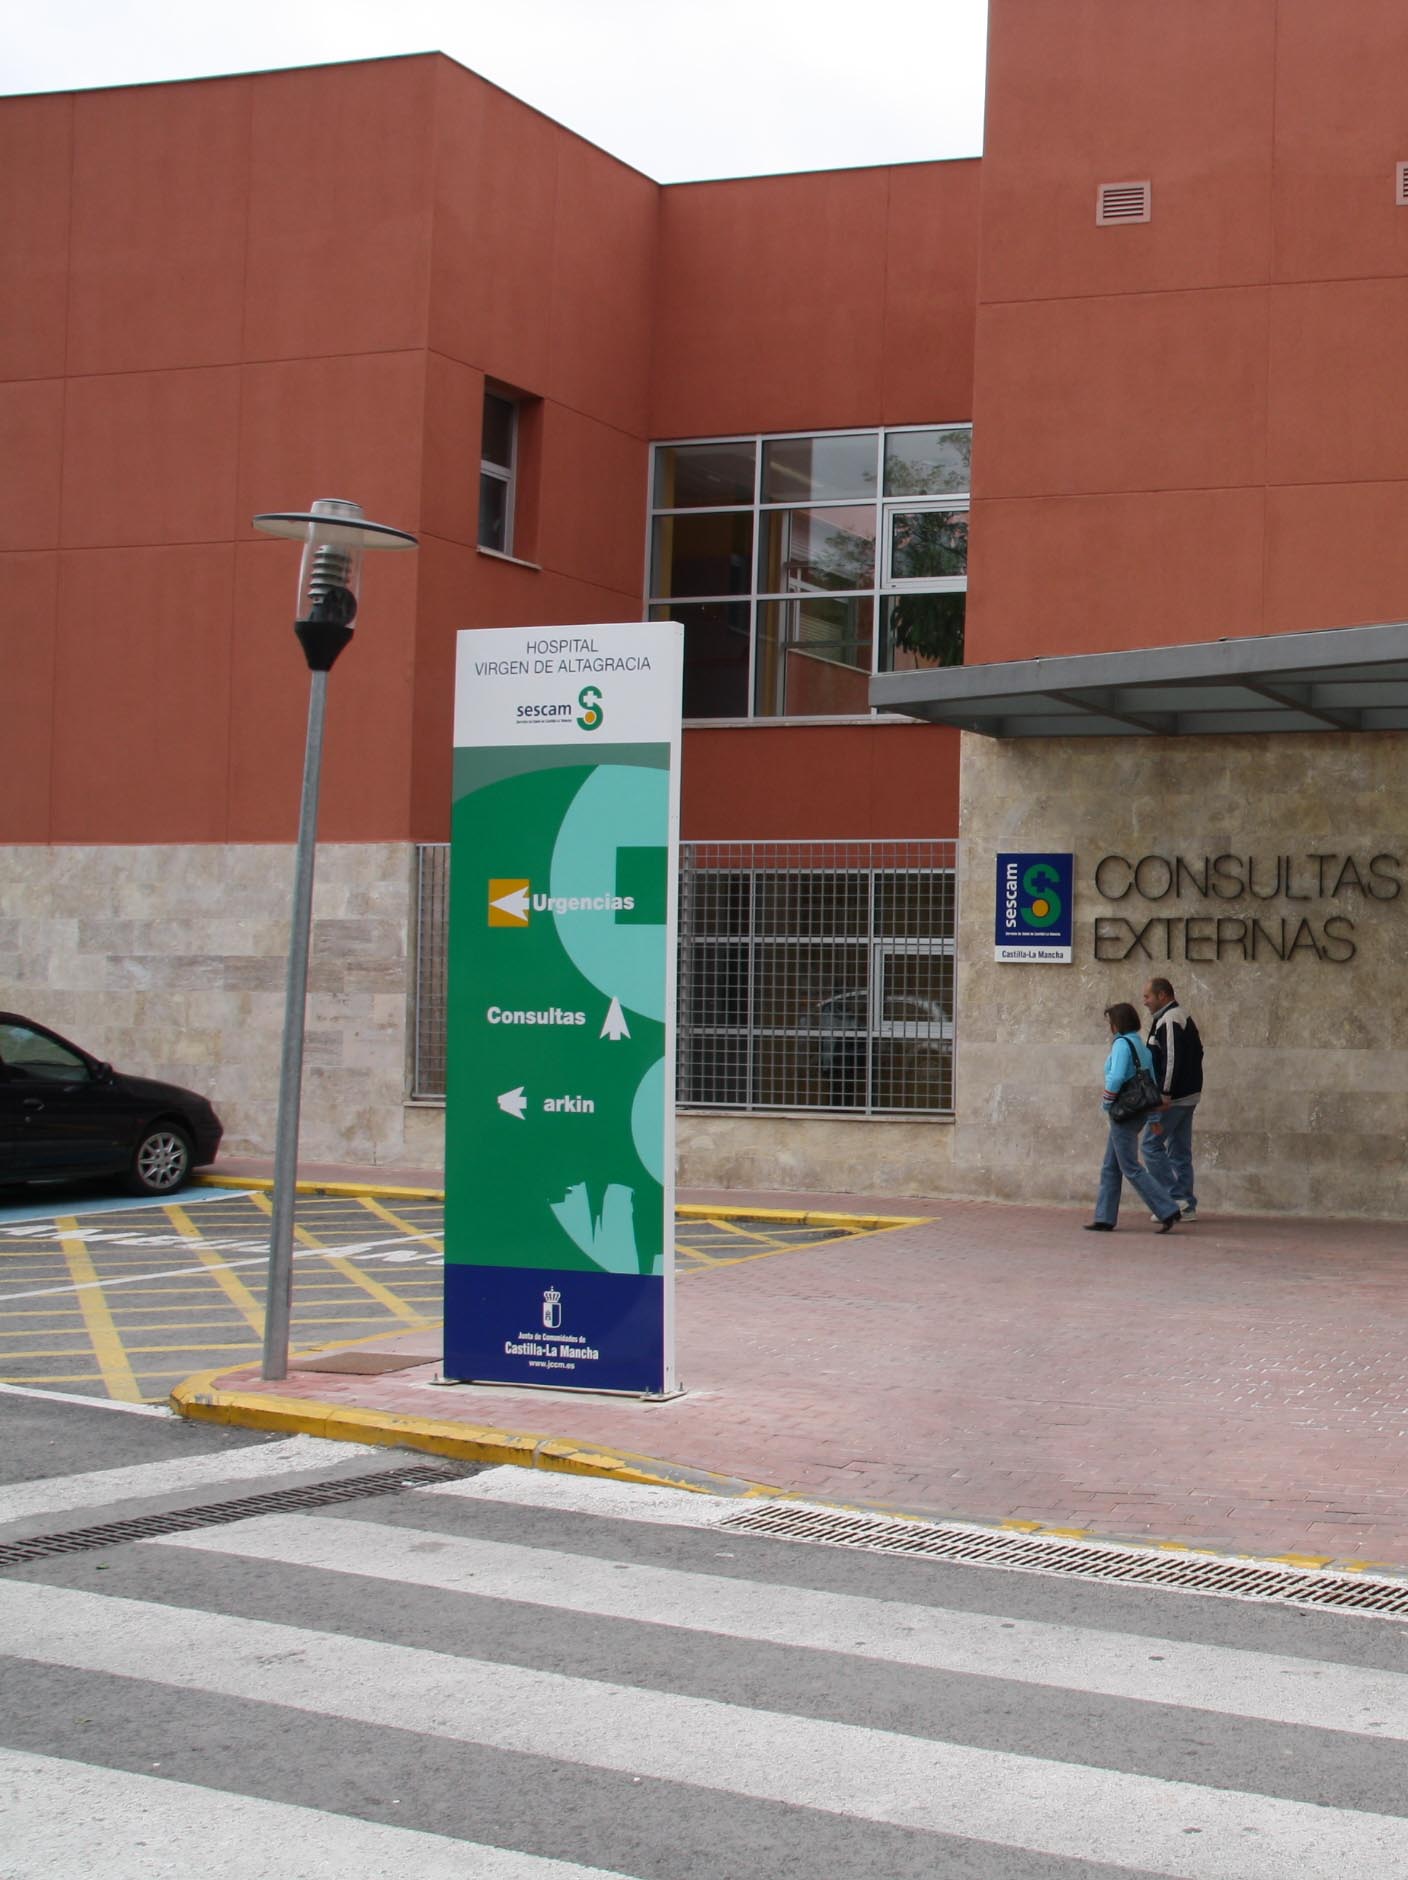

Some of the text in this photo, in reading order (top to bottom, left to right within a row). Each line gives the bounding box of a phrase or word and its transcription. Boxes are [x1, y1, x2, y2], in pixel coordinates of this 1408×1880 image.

[526, 639, 599, 655] HOSPITAL
[474, 656, 651, 676] VIRGEN DE ALTAGRACIA
[516, 703, 572, 718] sescam
[1094, 854, 1401, 901] CONSULTAS
[532, 893, 635, 914] Urgencias
[1005, 863, 1018, 928] sescam
[1093, 916, 1358, 963] EXTERNAS
[1002, 950, 1064, 959] Castilla-La Mancha
[487, 1006, 586, 1025] Consultas
[518, 1332, 586, 1344] Junta de Comunidades de
[505, 1341, 599, 1360] Castilla-La Mancha
[528, 1359, 576, 1370] www.jccm.es
